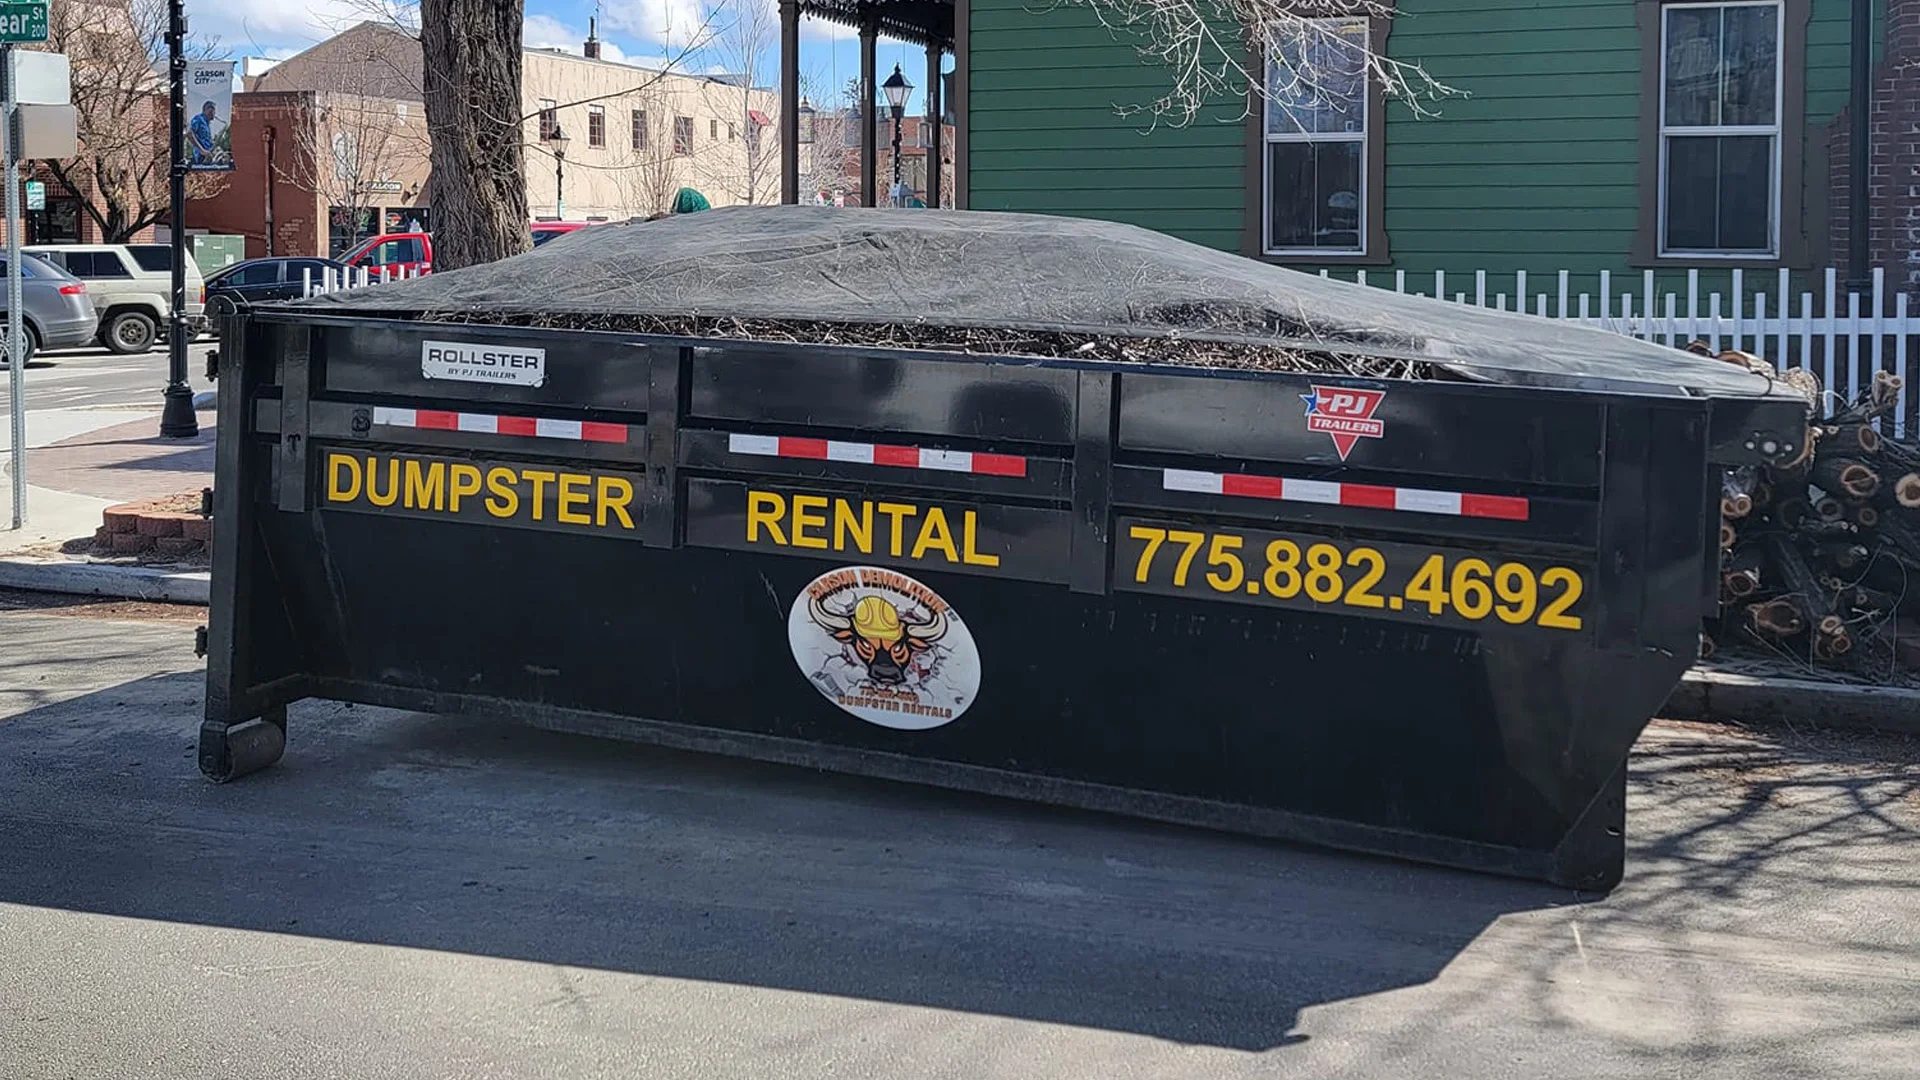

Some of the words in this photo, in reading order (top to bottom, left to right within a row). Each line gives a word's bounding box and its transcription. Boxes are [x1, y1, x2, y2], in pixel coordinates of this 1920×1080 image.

[32, 6, 44, 20] St
[31, 23, 46, 38] 200
[194, 70, 225, 78] CARSON
[194, 77, 211, 85] CITY
[428, 348, 538, 369] ROLLSTER
[462, 369, 473, 377] PJ
[475, 371, 517, 380] TRAILERS
[1329, 394, 1368, 415] PJ
[1314, 418, 1379, 434] TRAILERS
[328, 453, 635, 529] DUMPSTER
[746, 490, 1000, 567] RENTAL
[1129, 526, 1584, 630] 775.882.4692
[807, 569, 859, 602] CARSON
[859, 568, 946, 614] DEMOLITION
[838, 695, 900, 712] DUMPSTER
[902, 702, 953, 719] RENTALS
